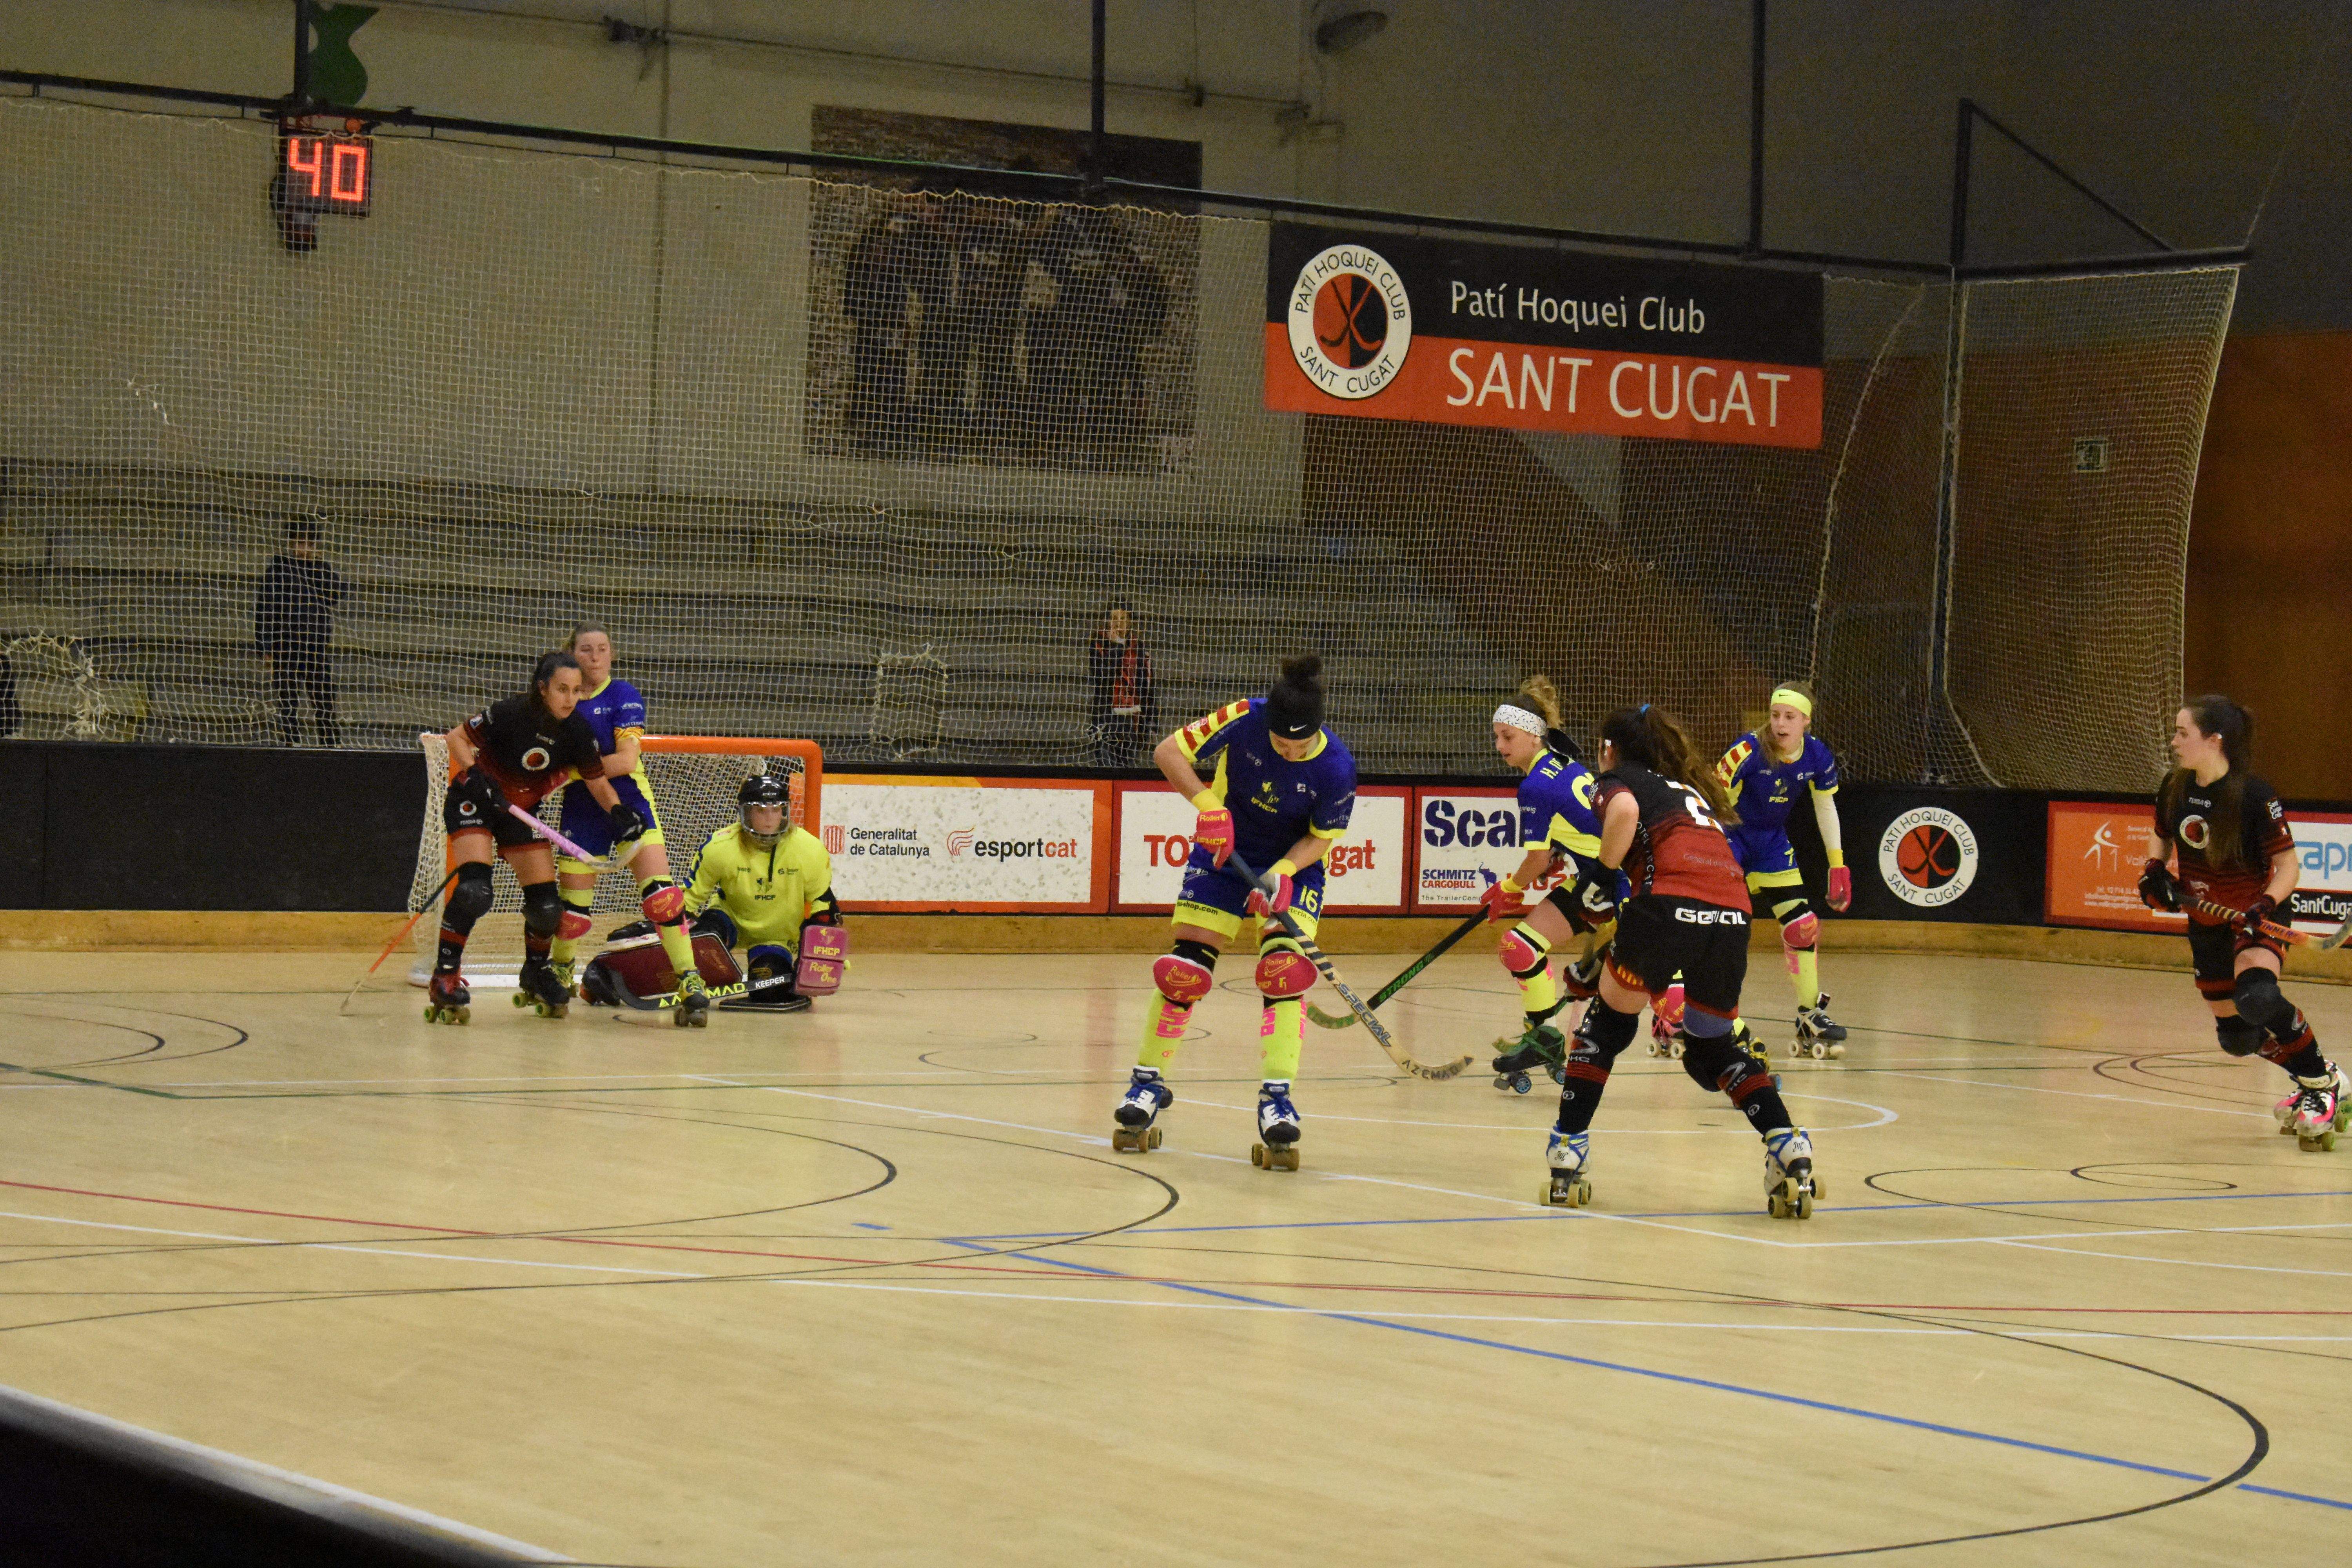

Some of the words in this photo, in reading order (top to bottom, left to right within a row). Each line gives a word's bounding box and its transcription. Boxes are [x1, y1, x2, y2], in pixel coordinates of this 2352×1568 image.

[289, 138, 367, 201] 40
[1295, 274, 1316, 313] PATI
[1314, 251, 1379, 279] HOQUEI
[1380, 272, 1406, 321] CLUB
[1451, 280, 1508, 318] Patí
[1518, 287, 1627, 333] Hoquei
[1639, 296, 1705, 334] Club
[1300, 346, 1339, 387] SANT
[1347, 354, 1395, 393] CUGAT
[1446, 347, 1593, 414] SANT
[1609, 360, 1791, 428] CUGAT
[850, 827, 917, 840] Generalitat
[1424, 800, 1523, 848] Sca
[1883, 827, 1902, 853] PATI
[1899, 811, 1953, 829] HOQUEI
[1954, 824, 1974, 855] CLUB
[850, 843, 866, 855] de
[869, 843, 930, 859] Catalunya
[975, 838, 1077, 862] esportcat
[1327, 839, 1376, 877] gat
[1421, 880, 1476, 889] CARGOBULL
[1422, 869, 1476, 880] SCHMITZ
[1887, 873, 1918, 900] SANT
[1924, 878, 1965, 904] CUGAT
[1298, 885, 1319, 913] 16
[755, 976, 785, 989] KEEPER
[1378, 960, 1425, 1003] STRONG
[1334, 982, 1392, 1047] SPECIAL
[1402, 1059, 1460, 1081] AZEMAD
